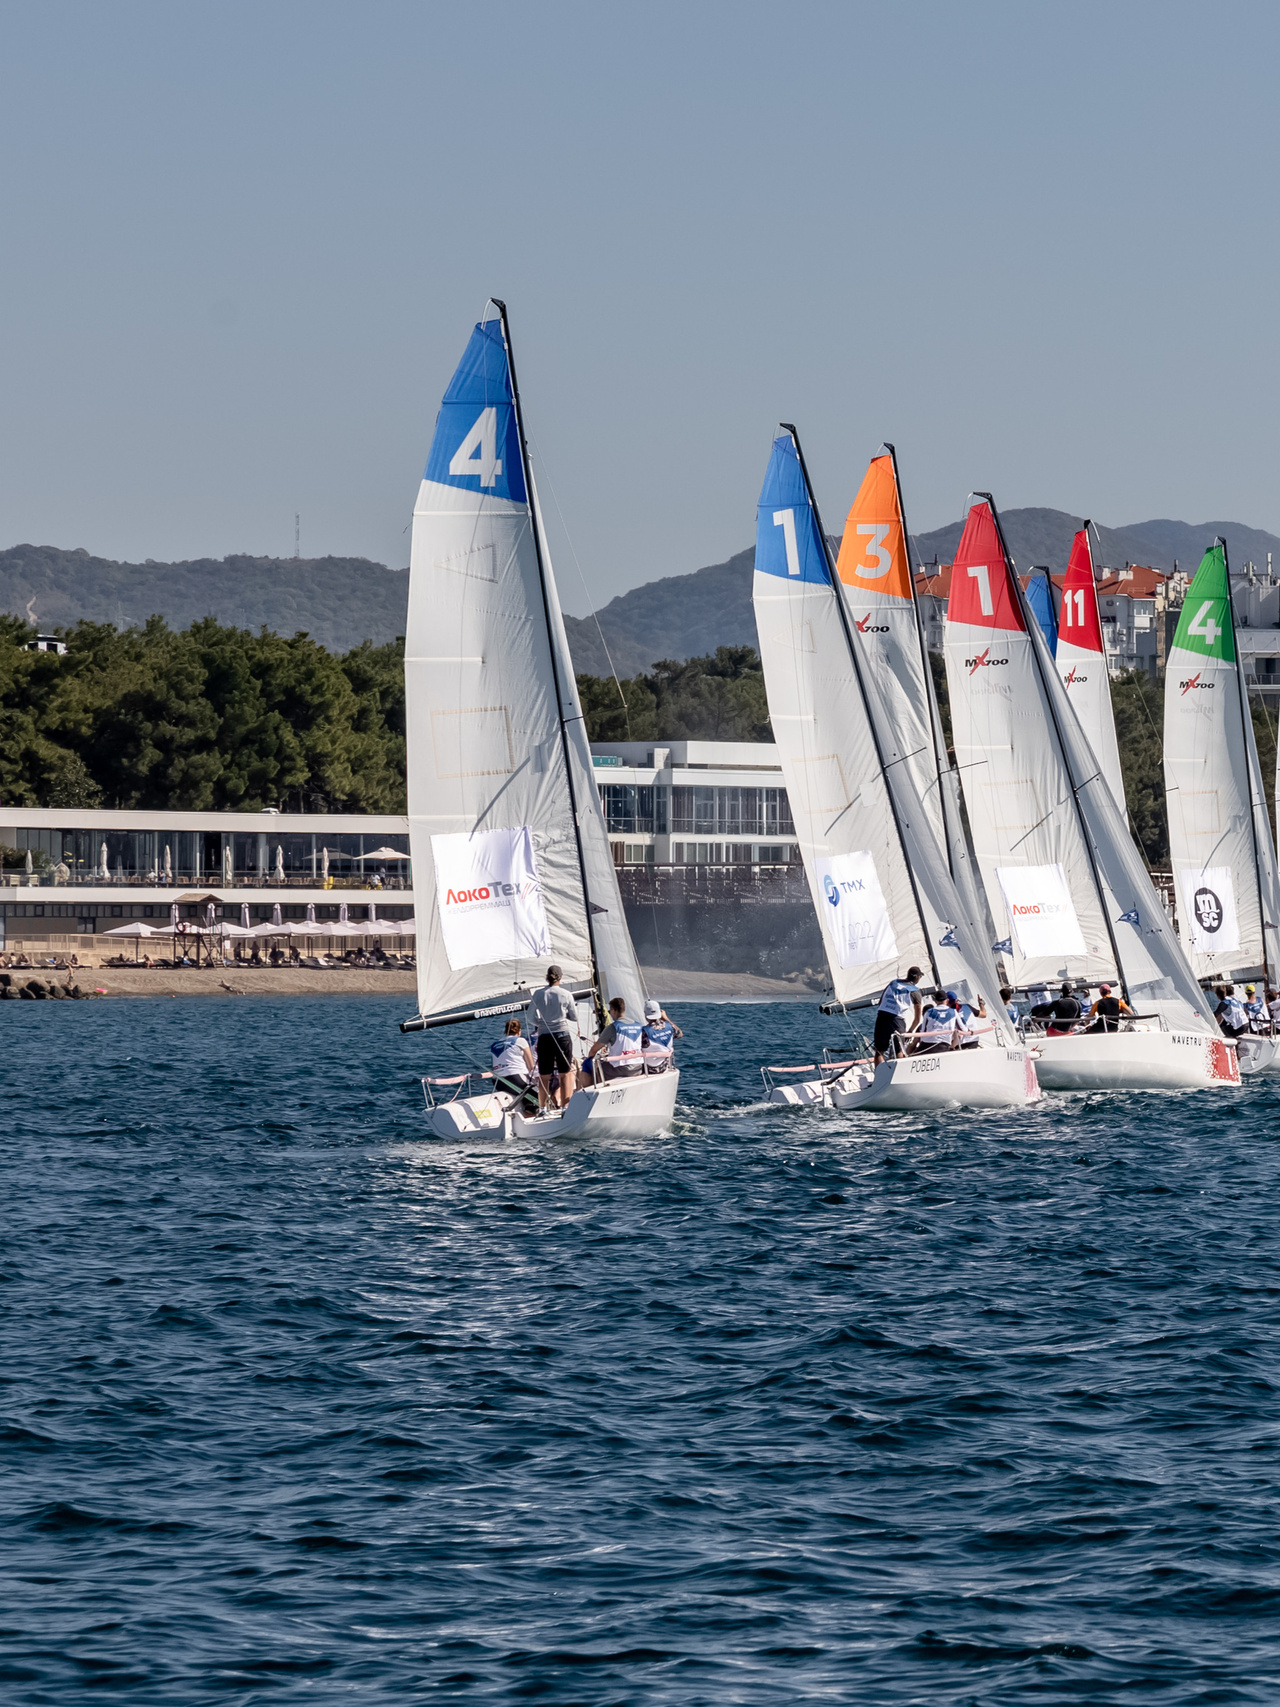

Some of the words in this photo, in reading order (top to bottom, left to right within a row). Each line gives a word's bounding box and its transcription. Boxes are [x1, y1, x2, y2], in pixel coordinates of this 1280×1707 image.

[449, 406, 503, 487] 4
[773, 508, 801, 576] 1
[855, 523, 892, 579] 3
[967, 565, 994, 616] 1
[1063, 589, 1085, 627] 11
[1187, 600, 1222, 645] 4
[1172, 1036, 1201, 1046] NAVETRU
[1225, 1047, 1234, 1075] 1
[911, 1058, 941, 1073] POBEDA
[609, 1088, 628, 1105] TORY
